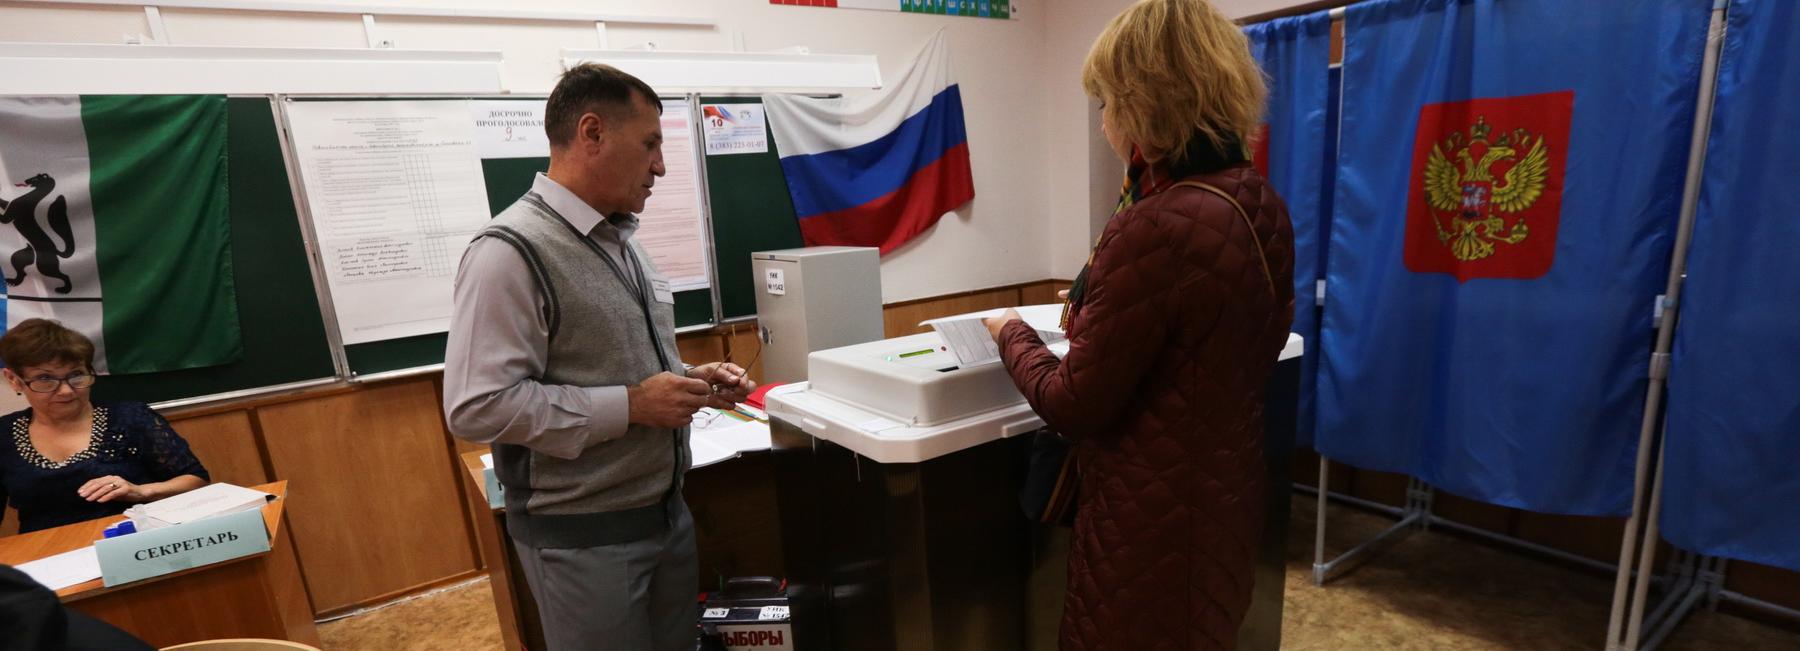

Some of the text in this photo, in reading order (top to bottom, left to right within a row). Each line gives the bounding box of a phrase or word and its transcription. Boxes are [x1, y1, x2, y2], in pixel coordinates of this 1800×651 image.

[488, 110, 533, 119] ДОСРОЧНО
[711, 118, 723, 128] 10
[505, 127, 512, 141] 9
[134, 531, 239, 561] СЕКРЕТАРЬ
